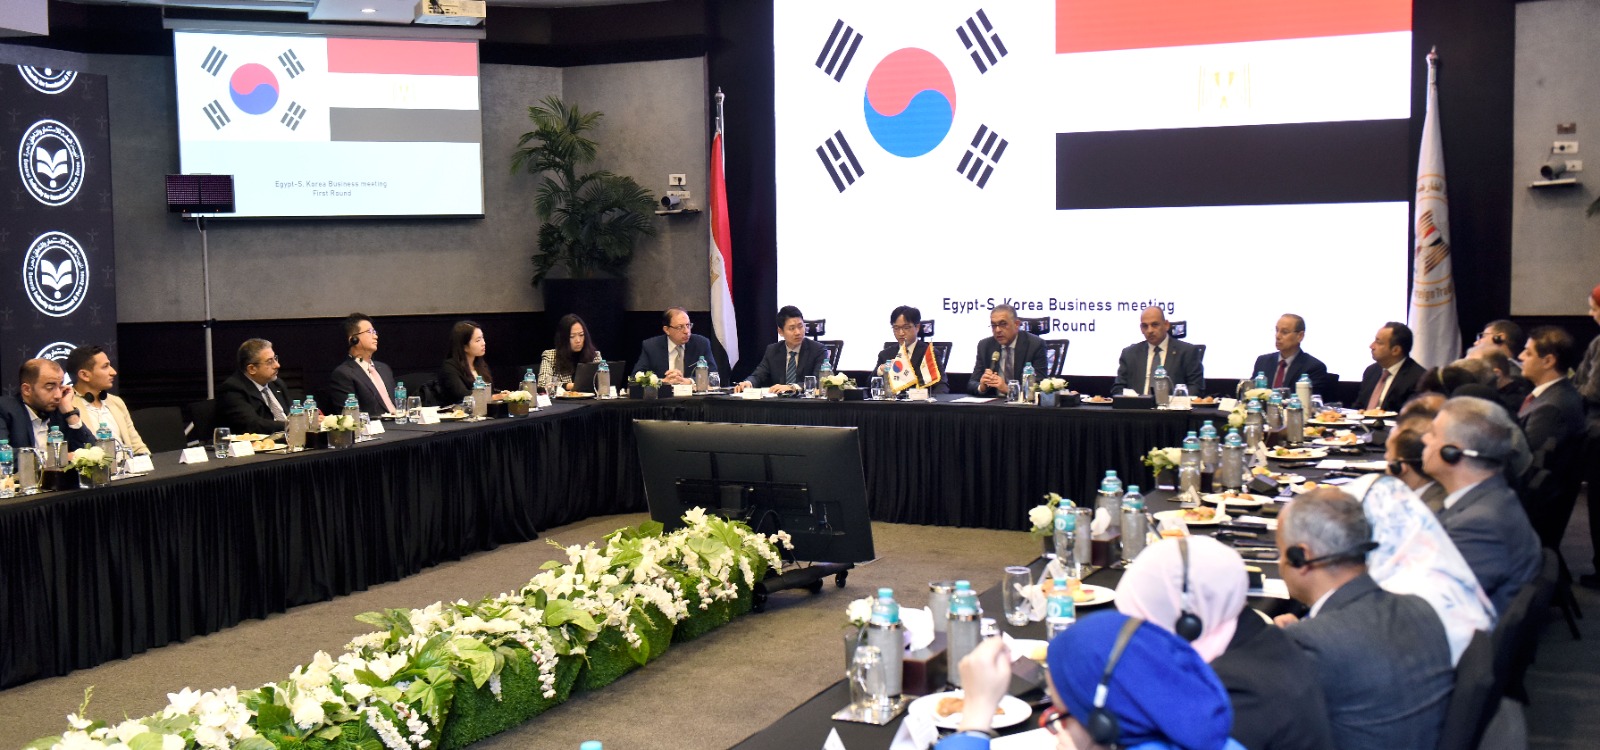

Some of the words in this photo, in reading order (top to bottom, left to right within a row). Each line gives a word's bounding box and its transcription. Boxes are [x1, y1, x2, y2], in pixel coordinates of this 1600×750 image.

[275, 180, 304, 188] Egypt-S.
[306, 180, 327, 188] Korea
[328, 180, 359, 188] Business
[361, 180, 387, 188] meeting
[312, 189, 329, 197] First
[330, 189, 352, 197] Round
[942, 297, 996, 314] Egypt-S
[1049, 297, 1112, 311] Business
[1052, 318, 1096, 332] Round
